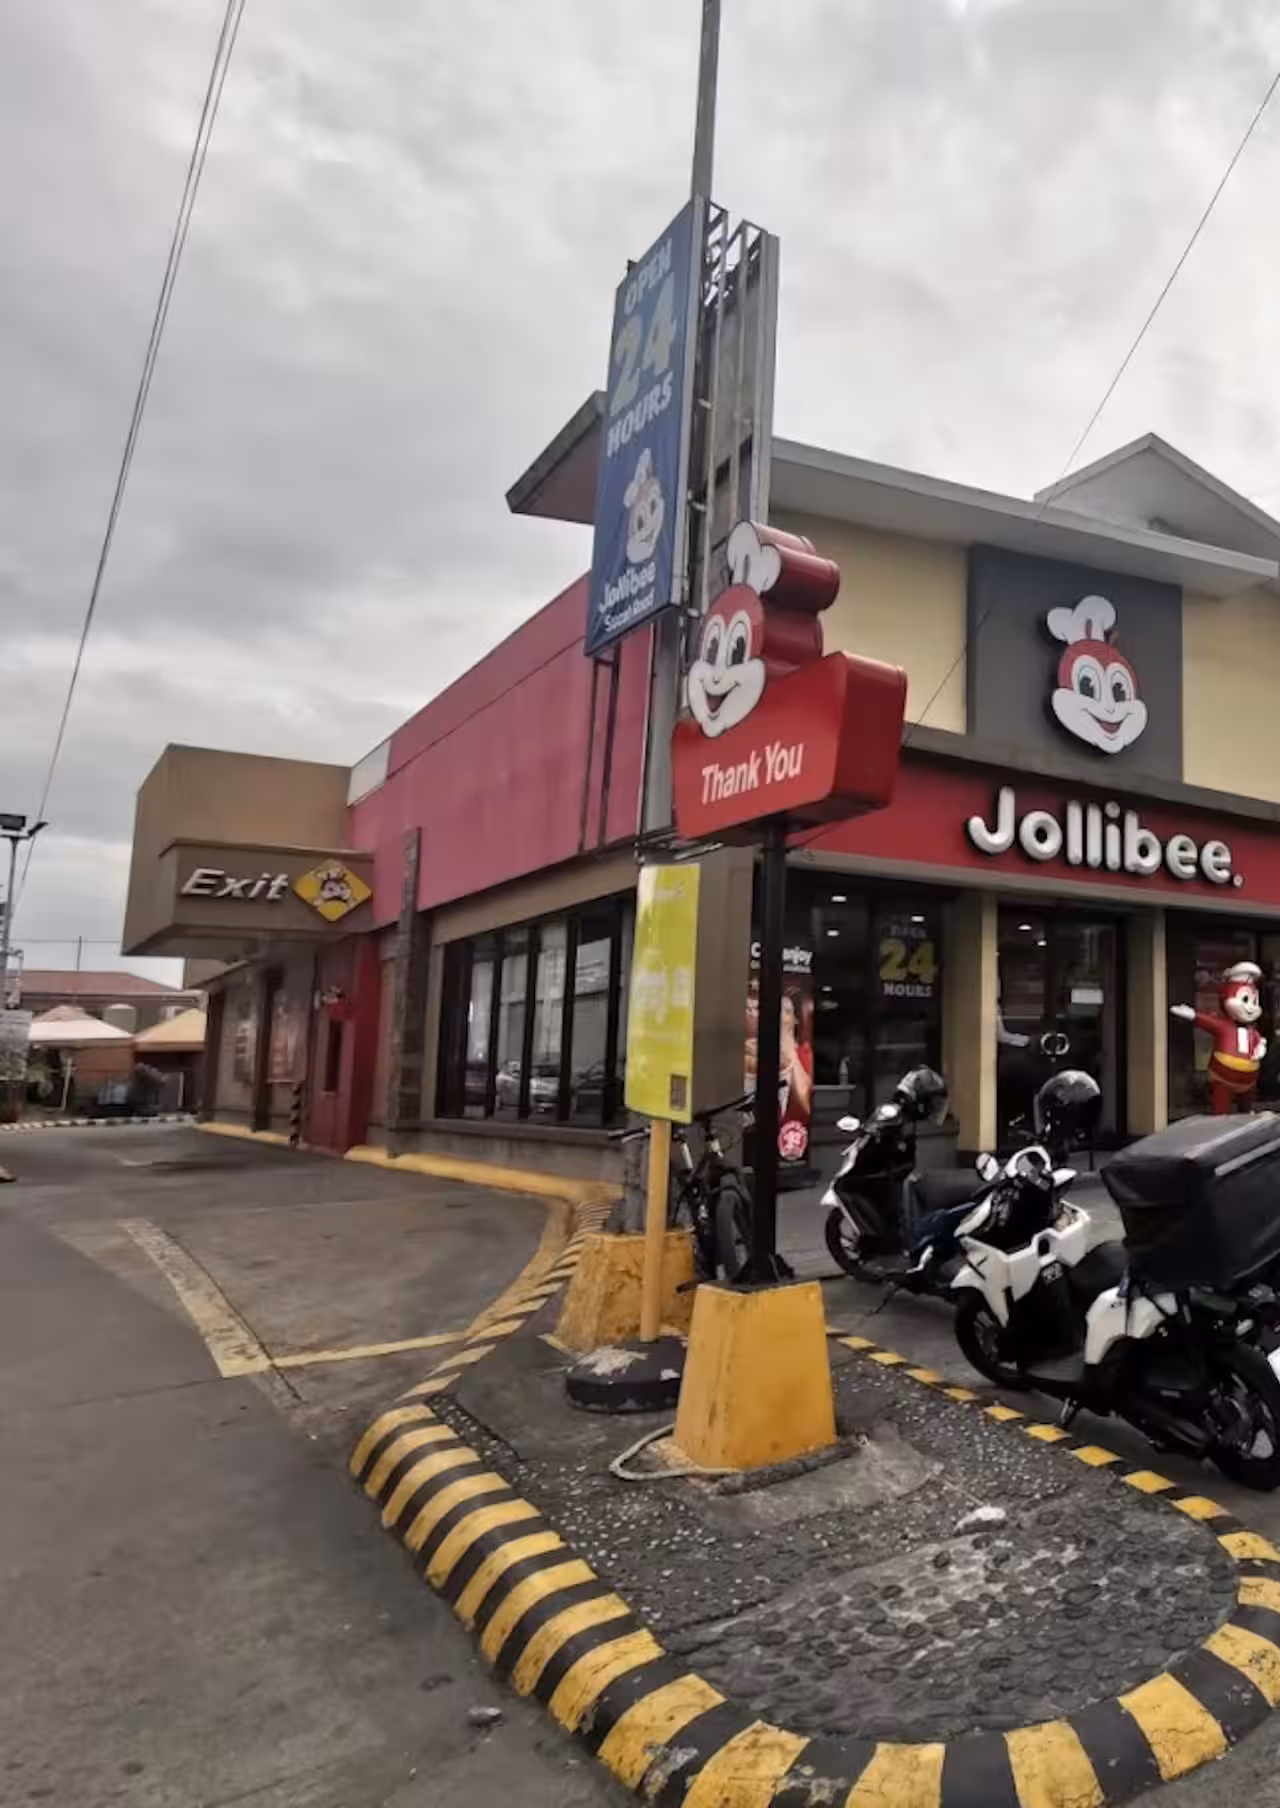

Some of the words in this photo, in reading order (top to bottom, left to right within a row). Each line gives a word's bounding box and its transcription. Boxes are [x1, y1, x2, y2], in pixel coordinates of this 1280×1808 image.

[624, 238, 673, 315] OPEN
[610, 271, 677, 416] 24
[607, 370, 674, 457] HOURS
[599, 561, 656, 613] Jollibee
[702, 750, 761, 805] Thank
[765, 740, 804, 785] You
[181, 867, 289, 899] Exit
[880, 939, 937, 984] 24
[883, 982, 932, 997] HOURS
